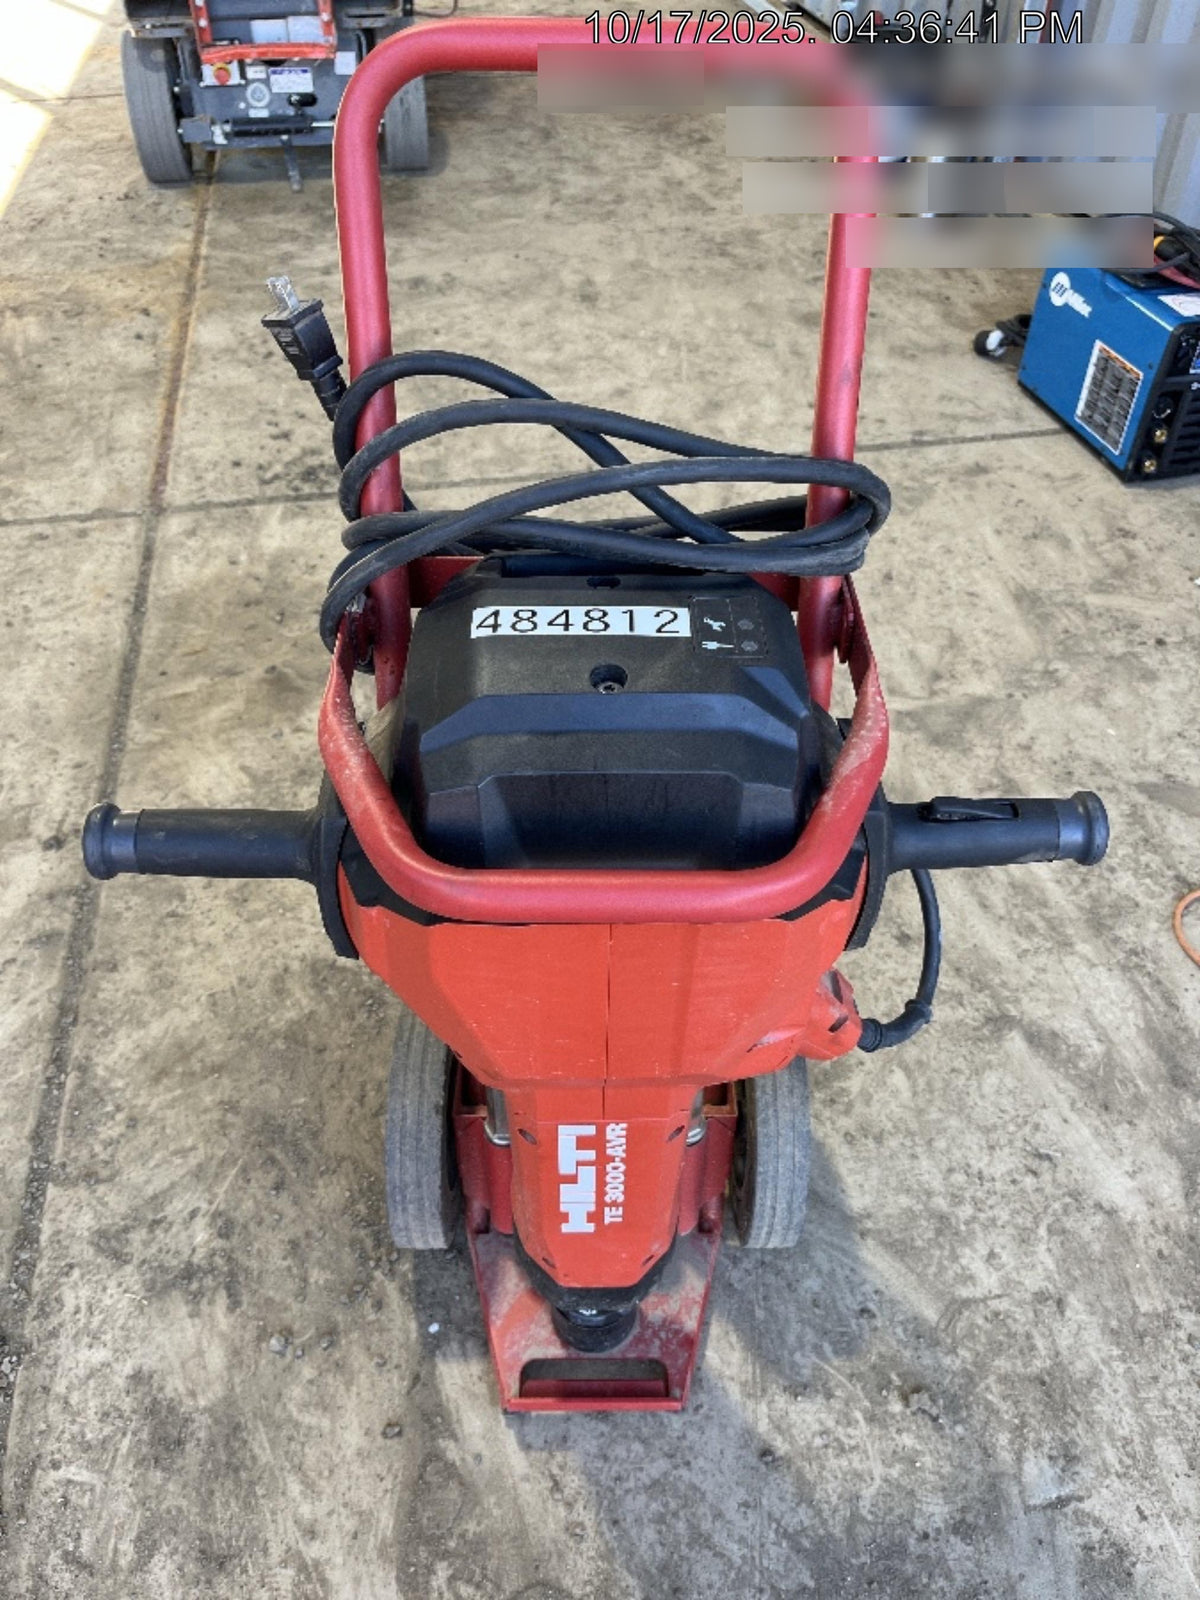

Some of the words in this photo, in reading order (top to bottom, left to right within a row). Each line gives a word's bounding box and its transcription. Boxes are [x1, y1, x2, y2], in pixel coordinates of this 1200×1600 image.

[475, 608, 681, 634] 484812
[557, 1124, 597, 1234] HILTI
[603, 1122, 629, 1204] 3000-AVR
[603, 1206, 623, 1226] TE
